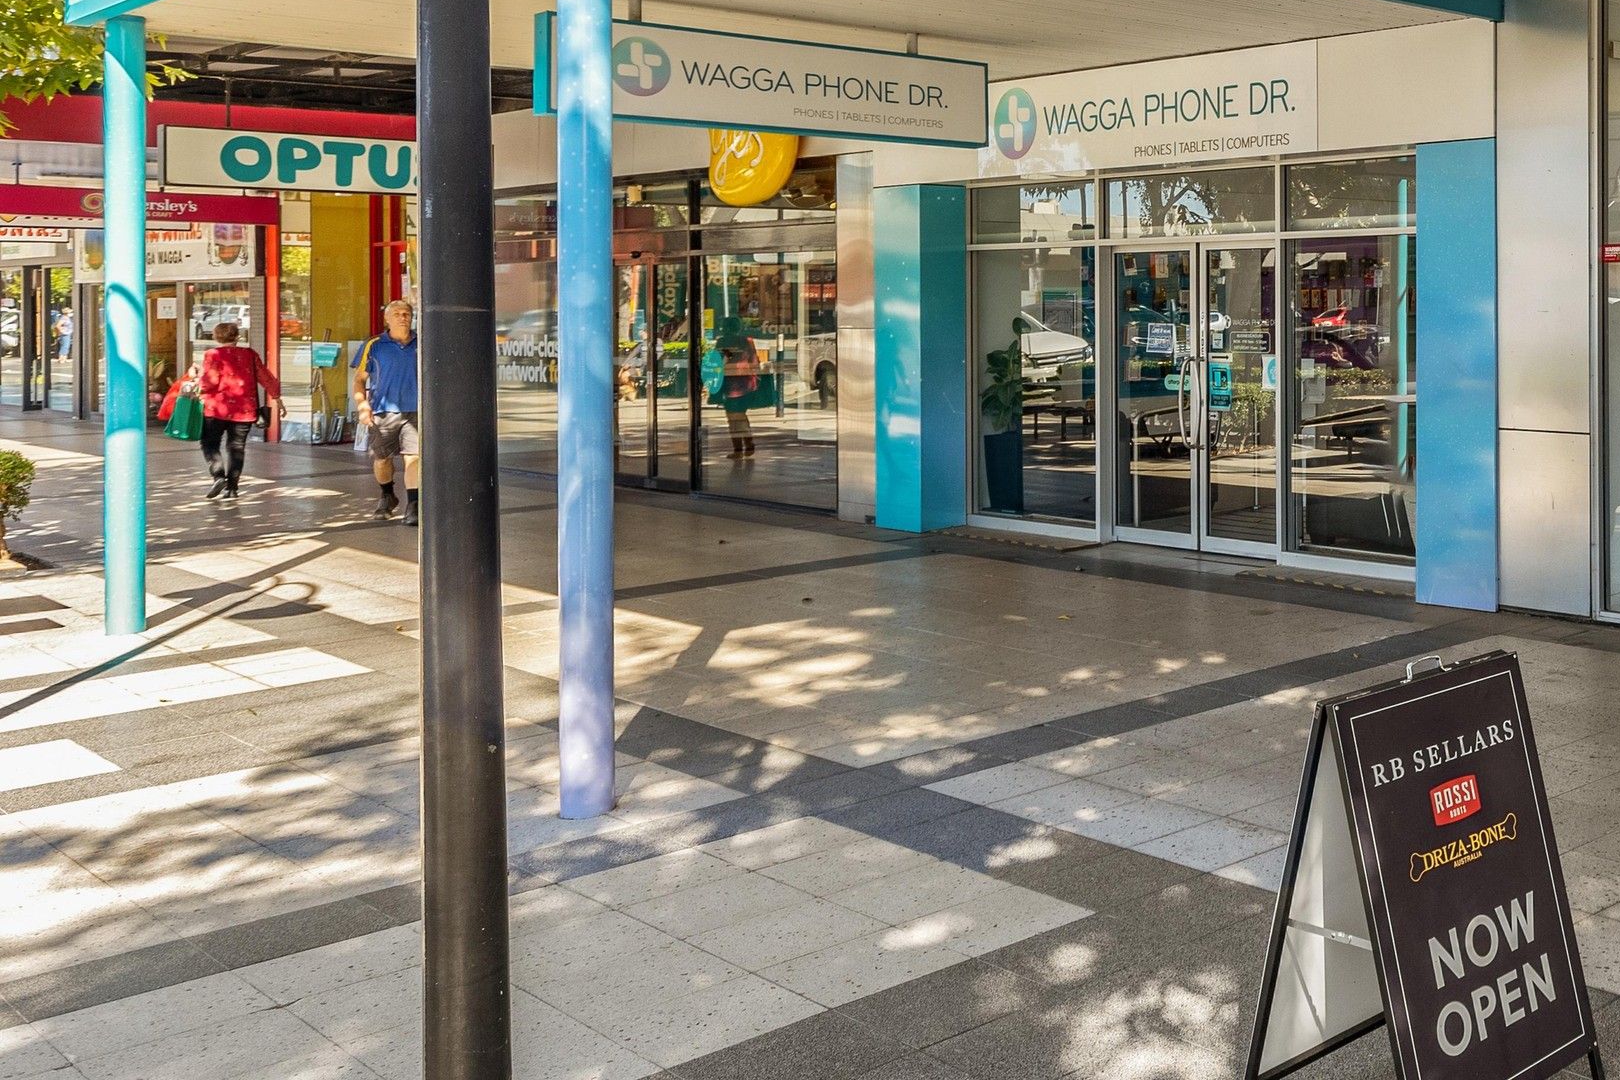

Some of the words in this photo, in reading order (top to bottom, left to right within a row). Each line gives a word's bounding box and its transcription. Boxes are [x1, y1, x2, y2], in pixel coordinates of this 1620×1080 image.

[681, 59, 795, 95] WAGGA
[804, 72, 900, 105] PHONE
[908, 84, 950, 109] DR.
[793, 107, 834, 120] PHONES
[841, 111, 881, 124] TABLETS
[887, 115, 944, 129] COMPUTERS
[1043, 97, 1135, 136] WAGGA
[1143, 84, 1239, 126] PHONE
[1249, 79, 1296, 116] DR.
[220, 135, 418, 189] OPTU
[1133, 142, 1173, 158] PHONES
[1178, 139, 1220, 154] TABLETS
[1226, 132, 1290, 150] COMPUTERS
[158, 250, 182, 265] WAGGA
[502, 335, 558, 358] world-clas
[498, 360, 547, 383] network
[1371, 758, 1406, 788] RB
[1413, 719, 1516, 774] SELLARS
[1433, 778, 1478, 814] ROSSI
[1449, 804, 1468, 820] BOOTS
[1422, 822, 1509, 873] DRIZA-BONE
[1453, 850, 1483, 869] AUSTRALIA
[1428, 890, 1536, 990] NOW
[1436, 952, 1558, 1058] OPEN
